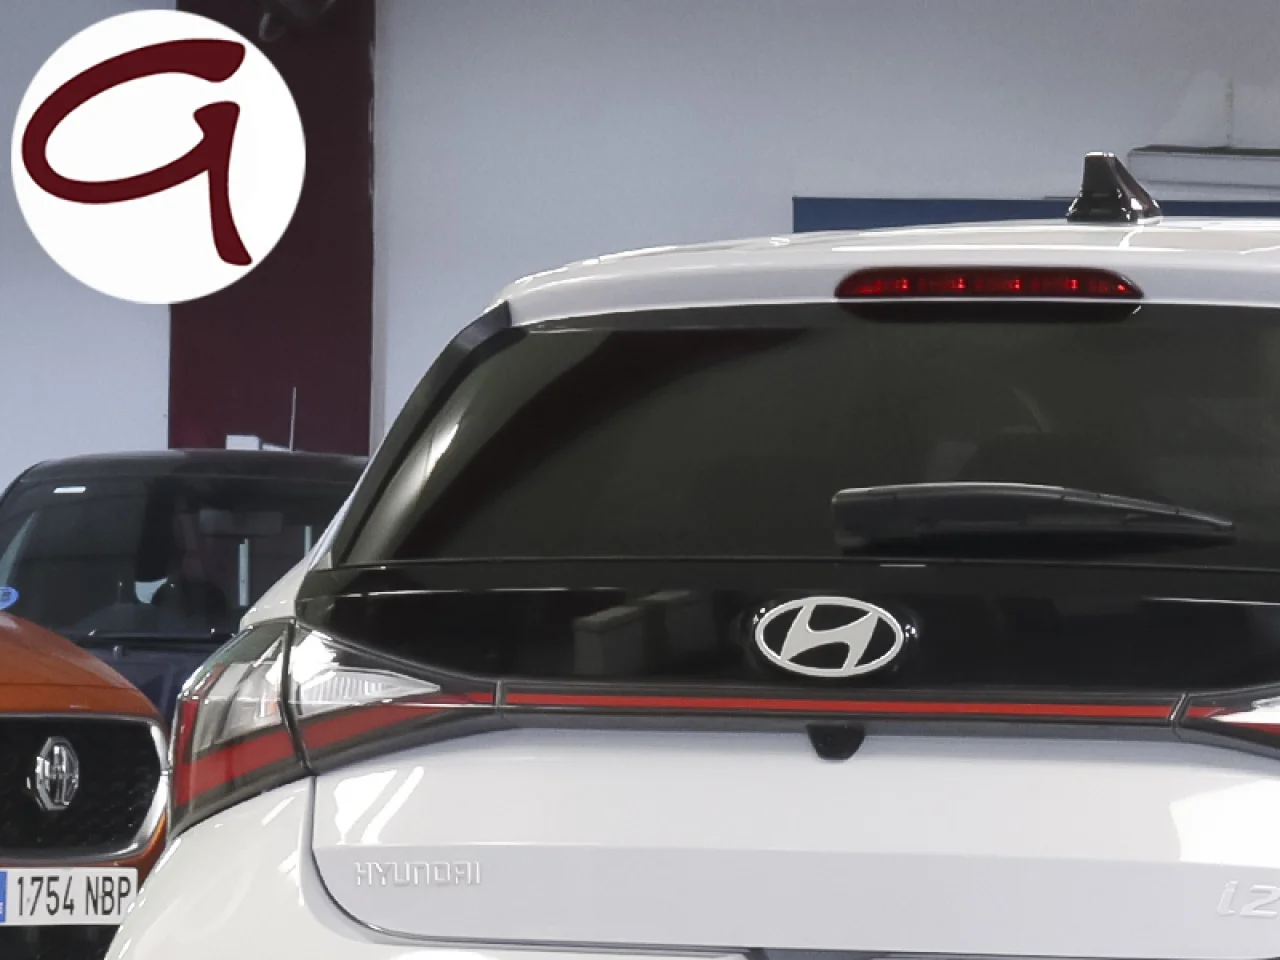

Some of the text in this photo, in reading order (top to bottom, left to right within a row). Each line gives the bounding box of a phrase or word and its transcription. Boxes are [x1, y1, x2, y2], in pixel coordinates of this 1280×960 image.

[354, 861, 481, 886] HYUNDAI
[17, 876, 131, 916] 1754 NBP
